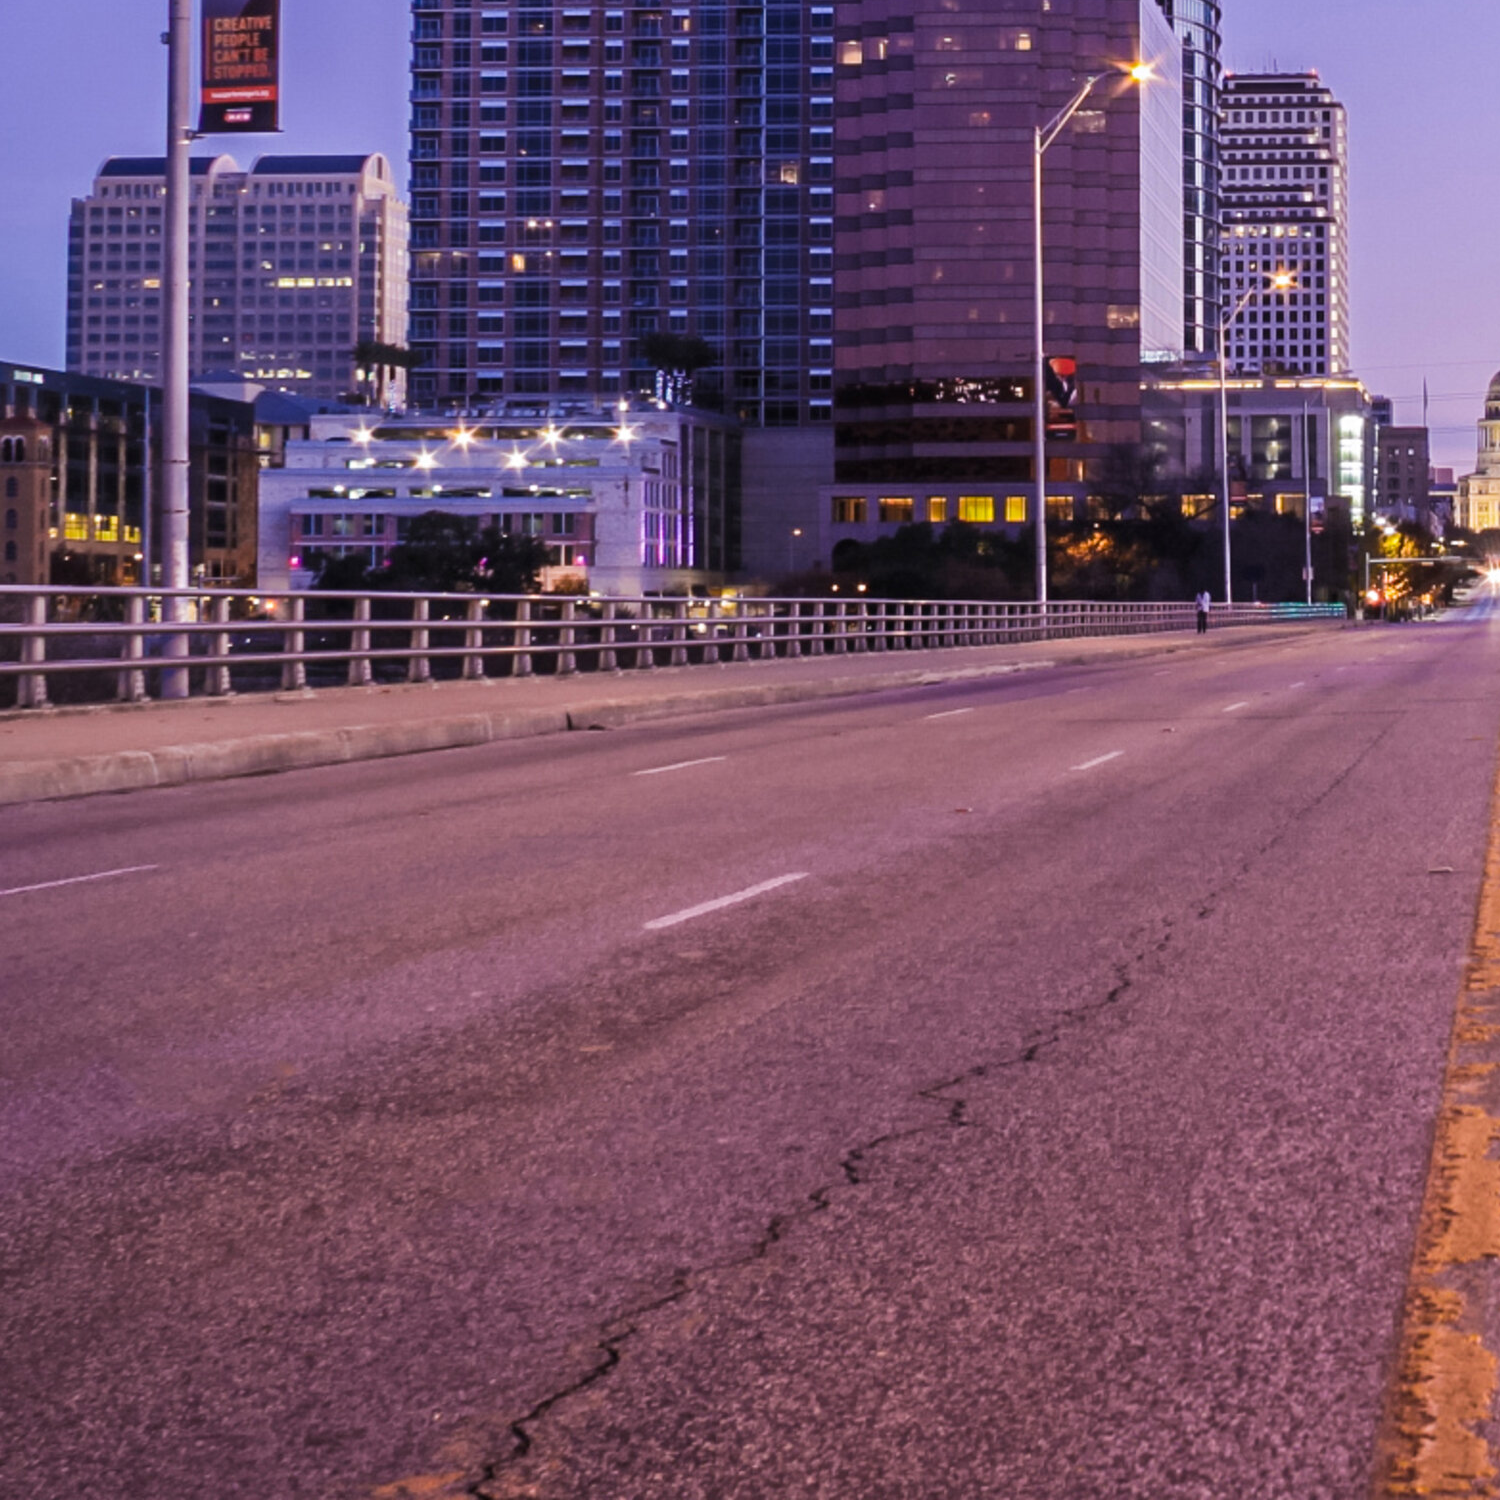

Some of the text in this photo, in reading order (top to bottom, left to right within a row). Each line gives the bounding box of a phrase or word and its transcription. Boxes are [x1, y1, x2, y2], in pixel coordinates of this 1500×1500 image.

[214, 15, 272, 31] CREATIVE
[214, 32, 260, 47] PEOPLE
[214, 47, 268, 63] CAN'T BE
